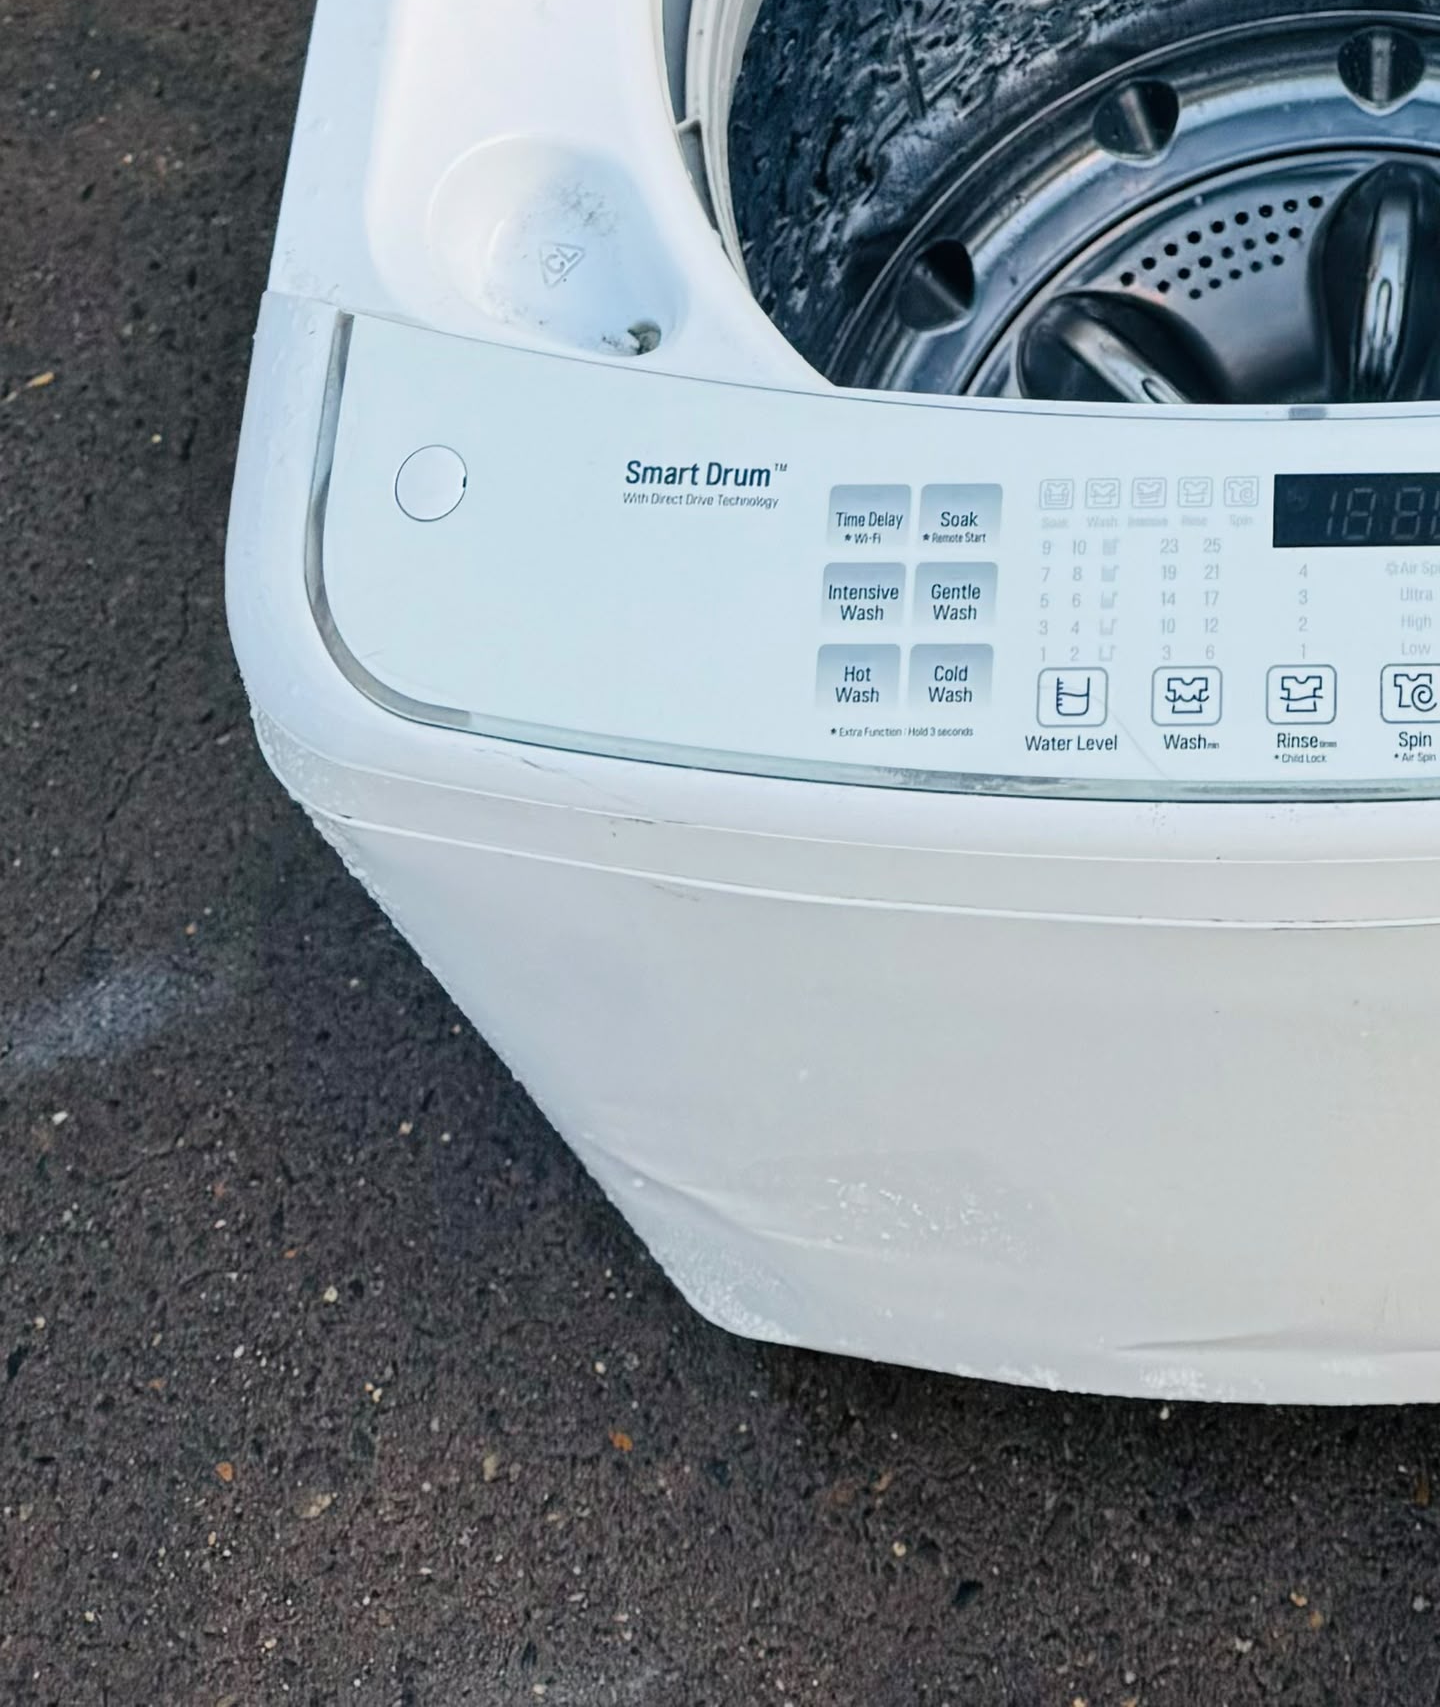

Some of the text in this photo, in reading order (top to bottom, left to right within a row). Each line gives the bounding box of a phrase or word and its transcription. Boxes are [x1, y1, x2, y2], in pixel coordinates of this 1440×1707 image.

[625, 460, 700, 485] Smart
[623, 492, 778, 510] With Direct Drive Technology
[835, 511, 904, 529] Time Delay
[940, 511, 978, 527] Soak
[854, 533, 881, 544] Wi-Fi
[931, 531, 986, 543] Remote Start
[1041, 539, 1087, 555] 9 10
[1160, 538, 1221, 555] 23 25
[1041, 566, 1082, 582] 7 8
[1161, 564, 1220, 580] 19 21
[1298, 564, 1308, 578] 4
[1400, 561, 1417, 576] Air
[828, 584, 899, 600] Intensive
[931, 584, 981, 600] Gentle
[1161, 590, 1219, 606] 14 17
[1298, 589, 1308, 605] 3
[1400, 587, 1433, 602] Ultra
[1039, 593, 1081, 608] 5 6
[840, 604, 884, 620] Wash
[932, 604, 977, 620] Wash
[1038, 620, 1080, 635] 3 4
[1161, 617, 1219, 634] 10 12
[1298, 617, 1308, 632] 2
[1400, 614, 1432, 631] High
[1040, 646, 1080, 662] 1 2
[1162, 644, 1215, 661] 3 6
[1300, 643, 1306, 659] 1
[1401, 640, 1431, 656] Low
[844, 665, 871, 682] Hot
[934, 665, 968, 682] Cold
[835, 687, 880, 703] Wash
[928, 686, 973, 702] Wash
[838, 727, 974, 737] Extra Function Hold 3 seconds
[1276, 732, 1318, 748] Rinse
[1024, 734, 1118, 751] Water Level
[1163, 734, 1207, 750] Wash
[1398, 731, 1432, 750] Spin
[1281, 754, 1327, 763] Child Lock
[1401, 752, 1437, 763] Air Spin
